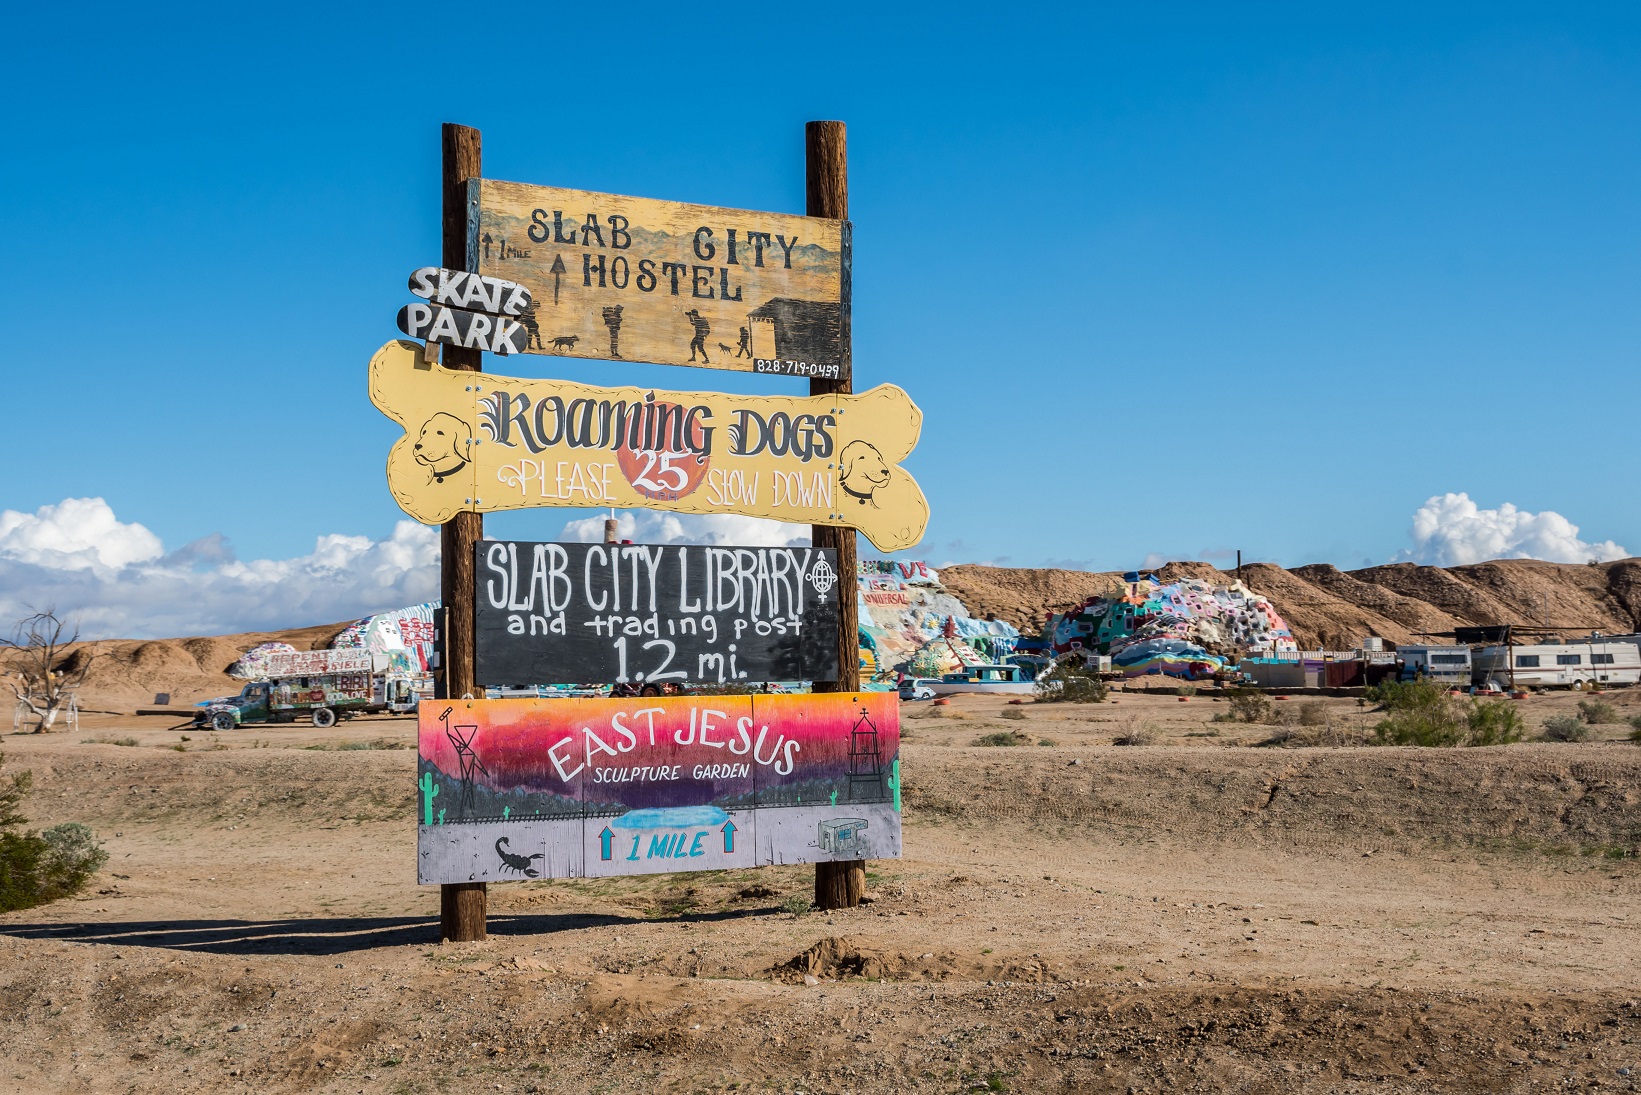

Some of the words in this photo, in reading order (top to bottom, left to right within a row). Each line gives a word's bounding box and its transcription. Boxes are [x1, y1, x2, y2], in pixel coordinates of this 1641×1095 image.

[499, 239, 506, 260] 1
[506, 246, 531, 259] MILE
[527, 208, 632, 250] SLAB
[693, 226, 799, 270] CITY
[411, 266, 532, 316] SKATE
[582, 253, 743, 302] HOSTEL
[407, 303, 519, 354] PARK
[727, 409, 837, 464] DOGS
[497, 459, 618, 501] PLEASE
[706, 468, 759, 507] SLOW
[773, 470, 832, 509] DOWN
[631, 447, 693, 492] 25
[487, 543, 572, 617] SLAB
[584, 545, 664, 612] CITY
[679, 546, 812, 622] LIBRARY
[862, 593, 909, 605] UNIVERSAL
[507, 611, 567, 636] and
[584, 612, 718, 643] trading
[733, 617, 803, 640] post
[271, 652, 328, 664] REPENT
[331, 660, 369, 671] BIBLE
[613, 636, 688, 683] 1.2
[698, 643, 748, 683] mi.
[346, 690, 367, 700] LOVE
[547, 707, 665, 783] EAST
[674, 707, 800, 776] JESUS
[593, 765, 681, 784] SCULPTURE
[693, 763, 750, 780] GARDEN
[626, 835, 640, 861] 1
[647, 831, 710, 860] MILE
